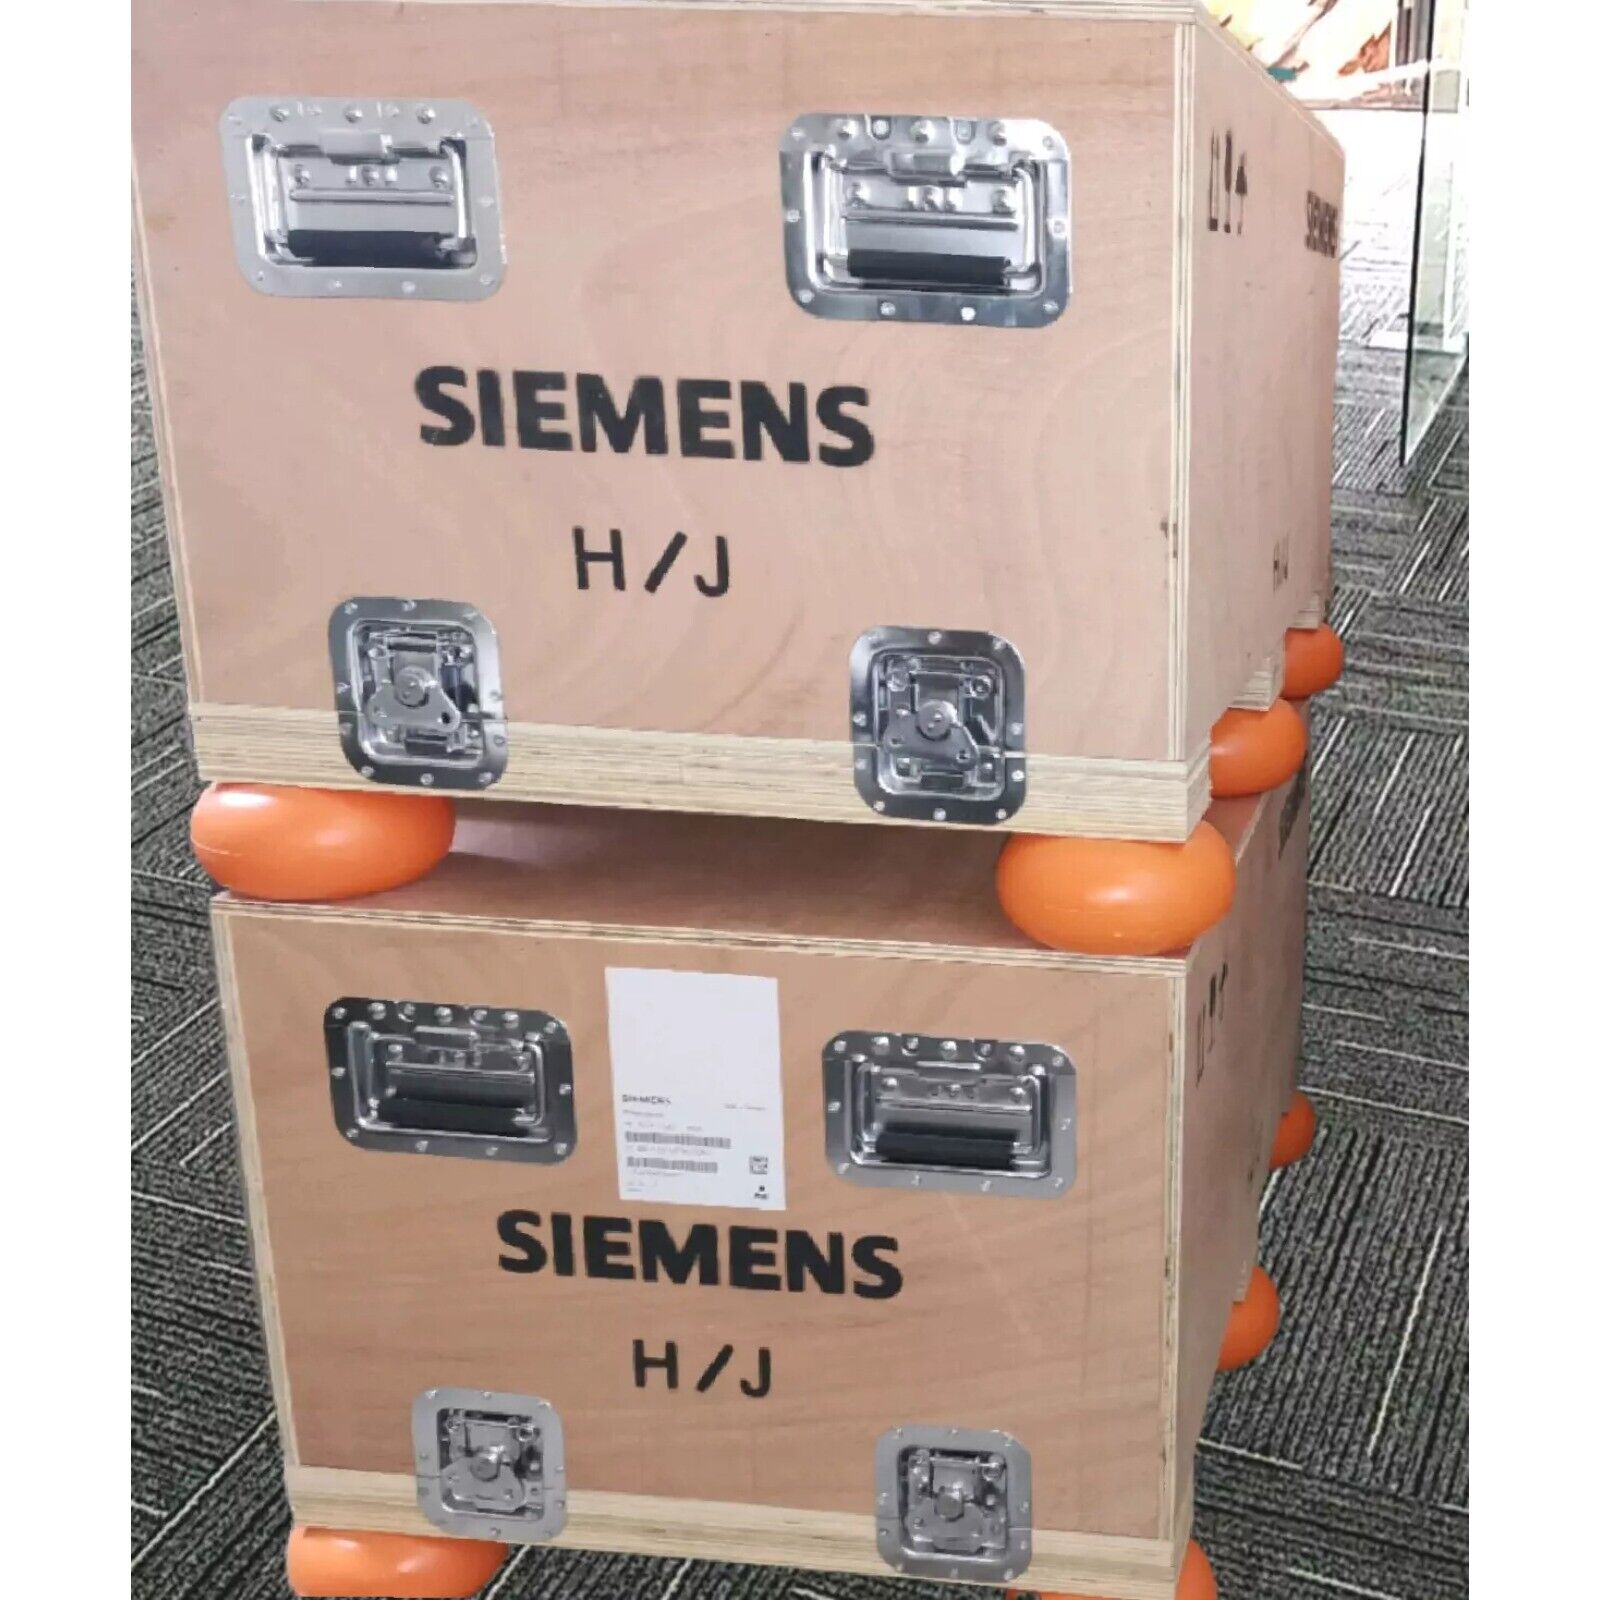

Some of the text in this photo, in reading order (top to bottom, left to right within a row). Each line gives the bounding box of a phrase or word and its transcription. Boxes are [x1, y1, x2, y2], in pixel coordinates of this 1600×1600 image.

[415, 365, 874, 467] SIEMENS
[572, 527, 730, 597] H/J
[496, 1209, 904, 1300] SIEMENS
[632, 1339, 772, 1398] H/J
